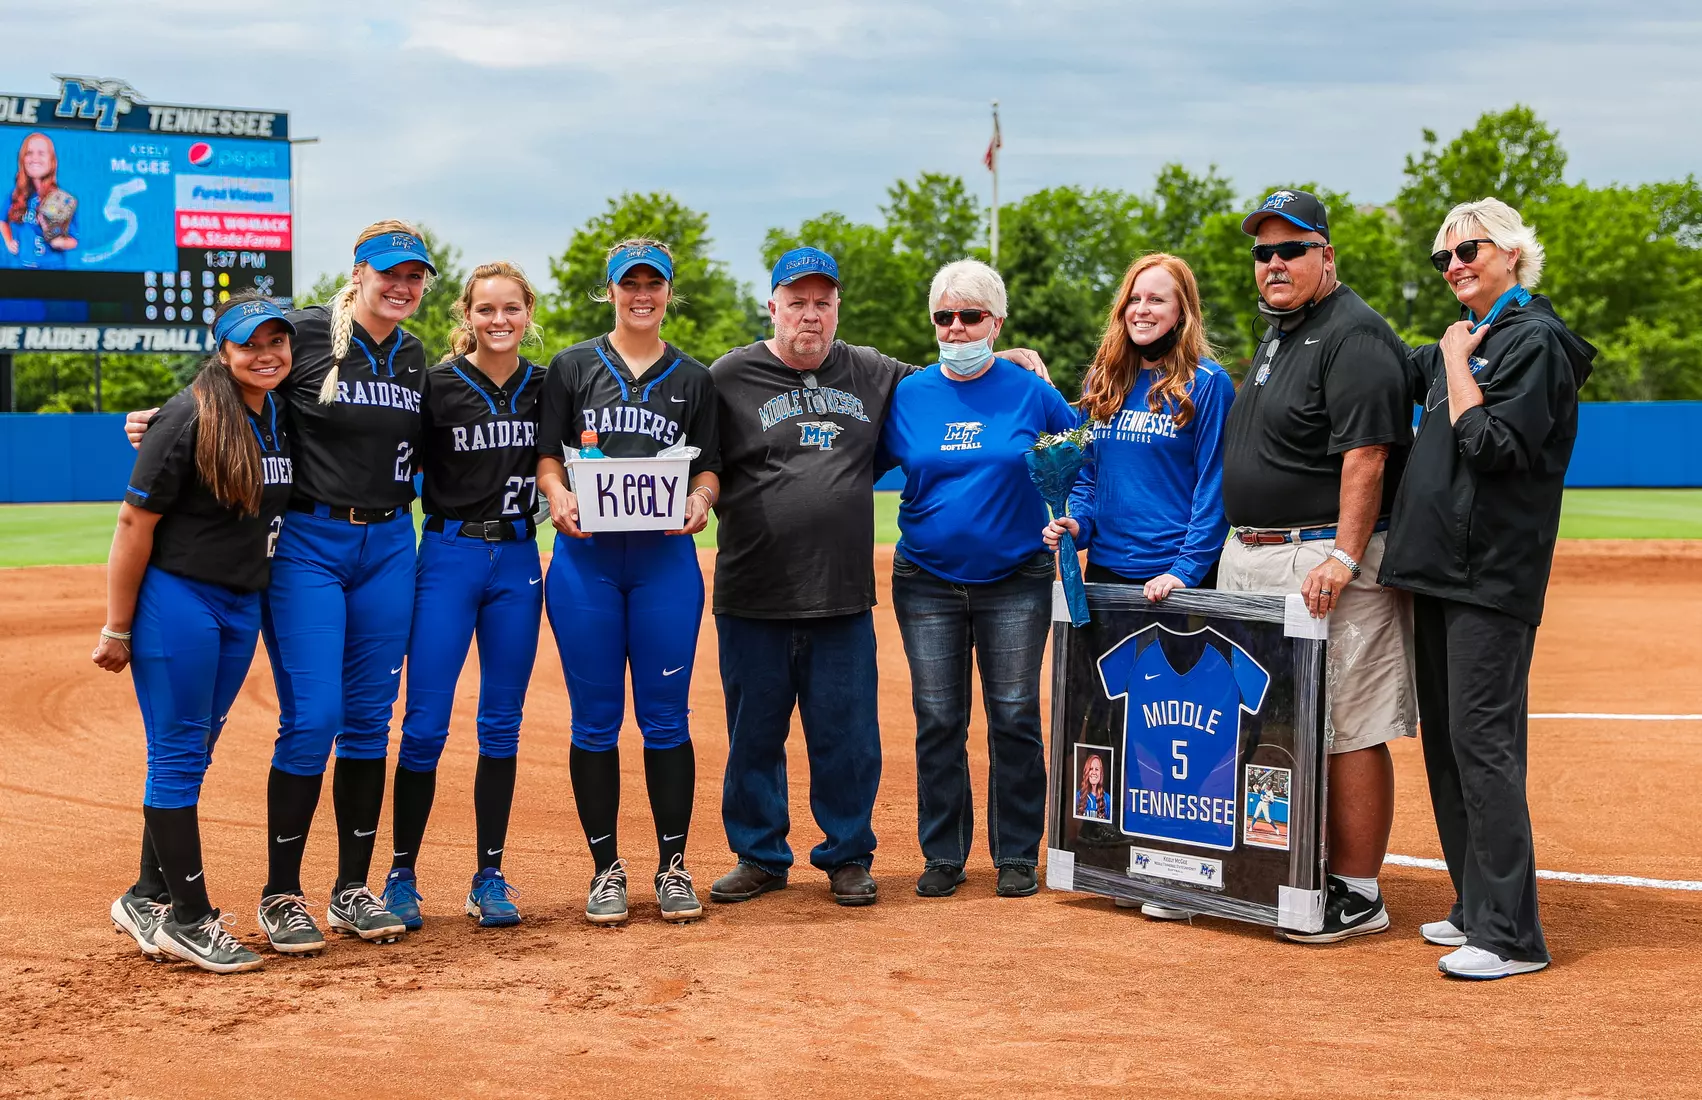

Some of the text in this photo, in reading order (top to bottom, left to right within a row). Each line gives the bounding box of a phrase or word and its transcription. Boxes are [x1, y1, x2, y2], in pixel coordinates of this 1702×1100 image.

[148, 107, 276, 137] TENNESSEE
[218, 149, 277, 170] pepsi
[81, 177, 147, 263] 5
[204, 251, 266, 269] 1:37 PM
[144, 271, 191, 287] R H E
[202, 271, 215, 288] B
[203, 289, 214, 306] S
[24, 326, 99, 350] RAIDER
[102, 328, 202, 350] SOFTBALL
[335, 381, 421, 413] RAIDERS
[758, 389, 804, 432] MIDDLE
[452, 421, 539, 451] RAIDER
[582, 406, 679, 445] RAIDERS
[799, 424, 836, 450] MT
[943, 424, 980, 443] MT
[1115, 431, 1151, 444] RAIDERS
[1116, 409, 1177, 439] TENNESSEE
[940, 442, 982, 451] SOFTBALL
[502, 475, 536, 515] 27
[1142, 700, 1222, 735] MIDDLE
[1172, 739, 1188, 780] 5
[1128, 788, 1234, 826] TENNESSEE
